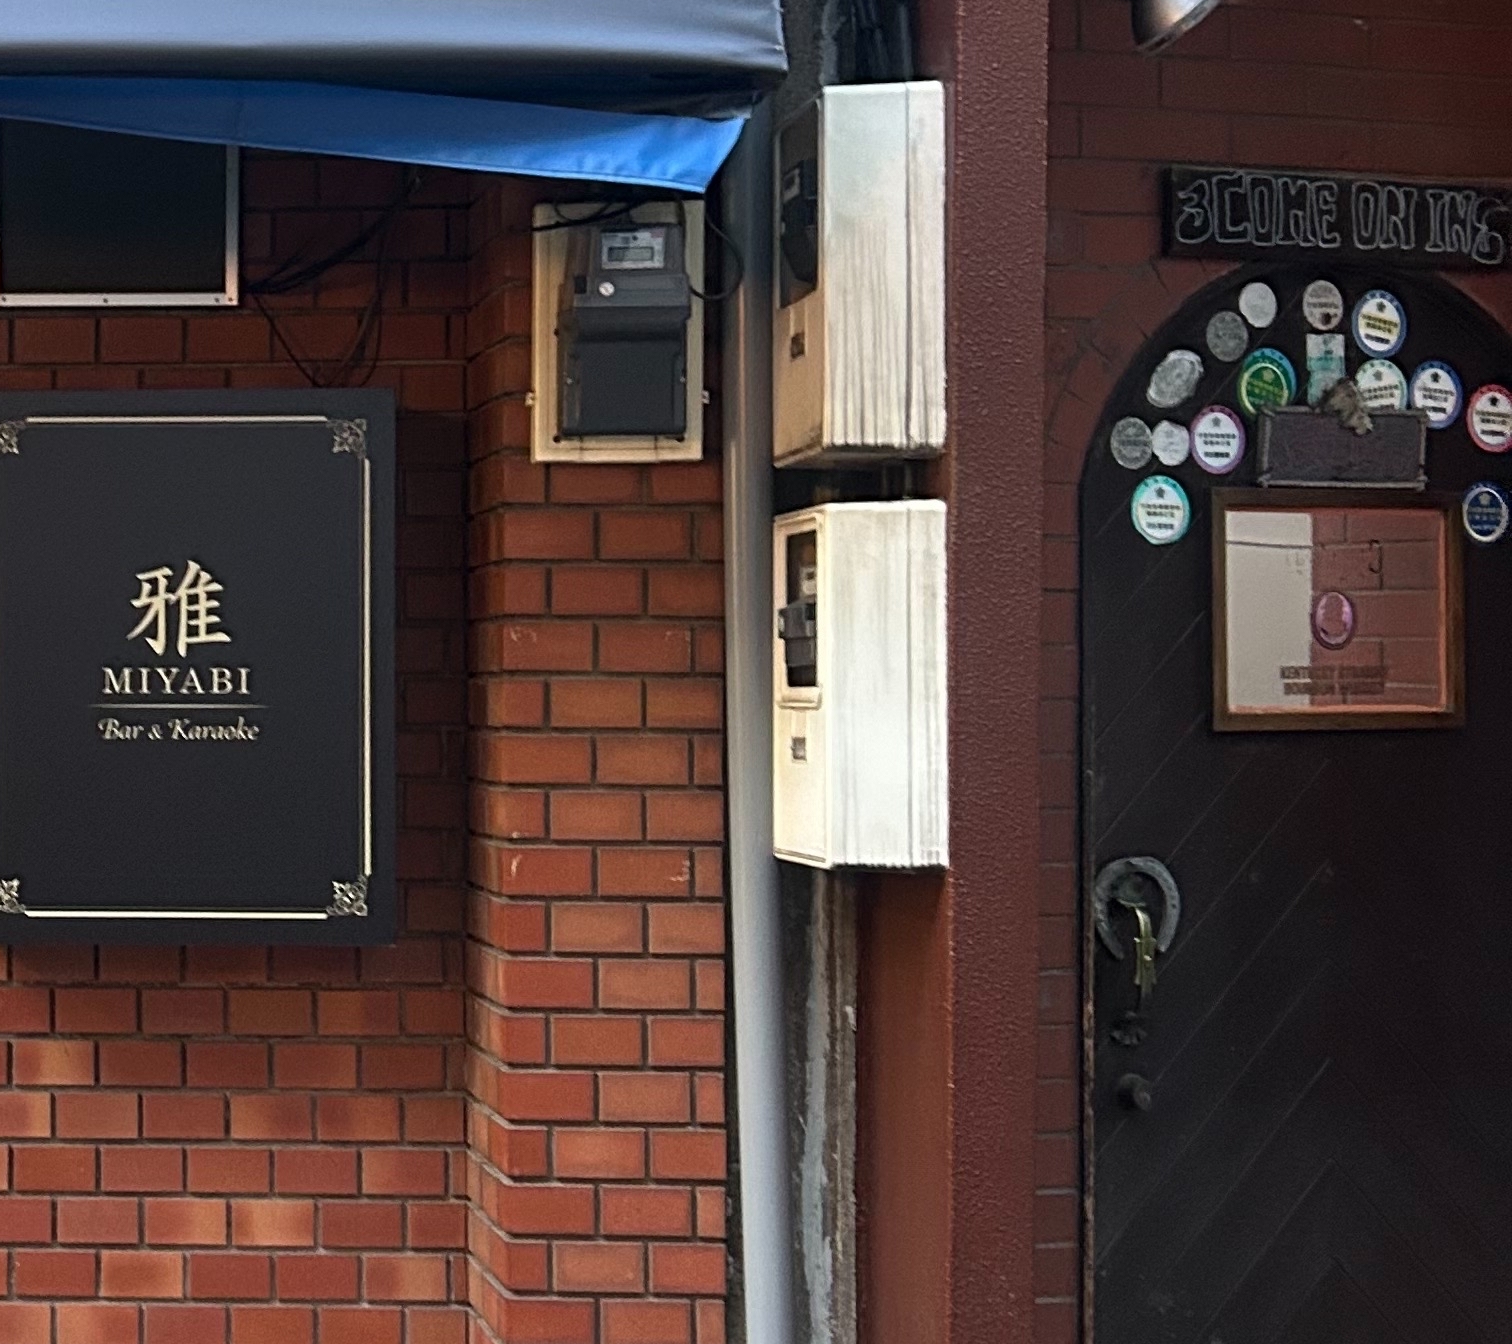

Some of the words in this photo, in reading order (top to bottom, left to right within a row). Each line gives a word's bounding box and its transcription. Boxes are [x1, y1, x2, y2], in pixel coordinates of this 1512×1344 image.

[1351, 181, 1418, 251] ON
[124, 559, 233, 659] 雅
[101, 666, 252, 696] MIYABI
[97, 717, 145, 741] Bar
[147, 723, 164, 741] &
[167, 715, 261, 741] Karaoke
